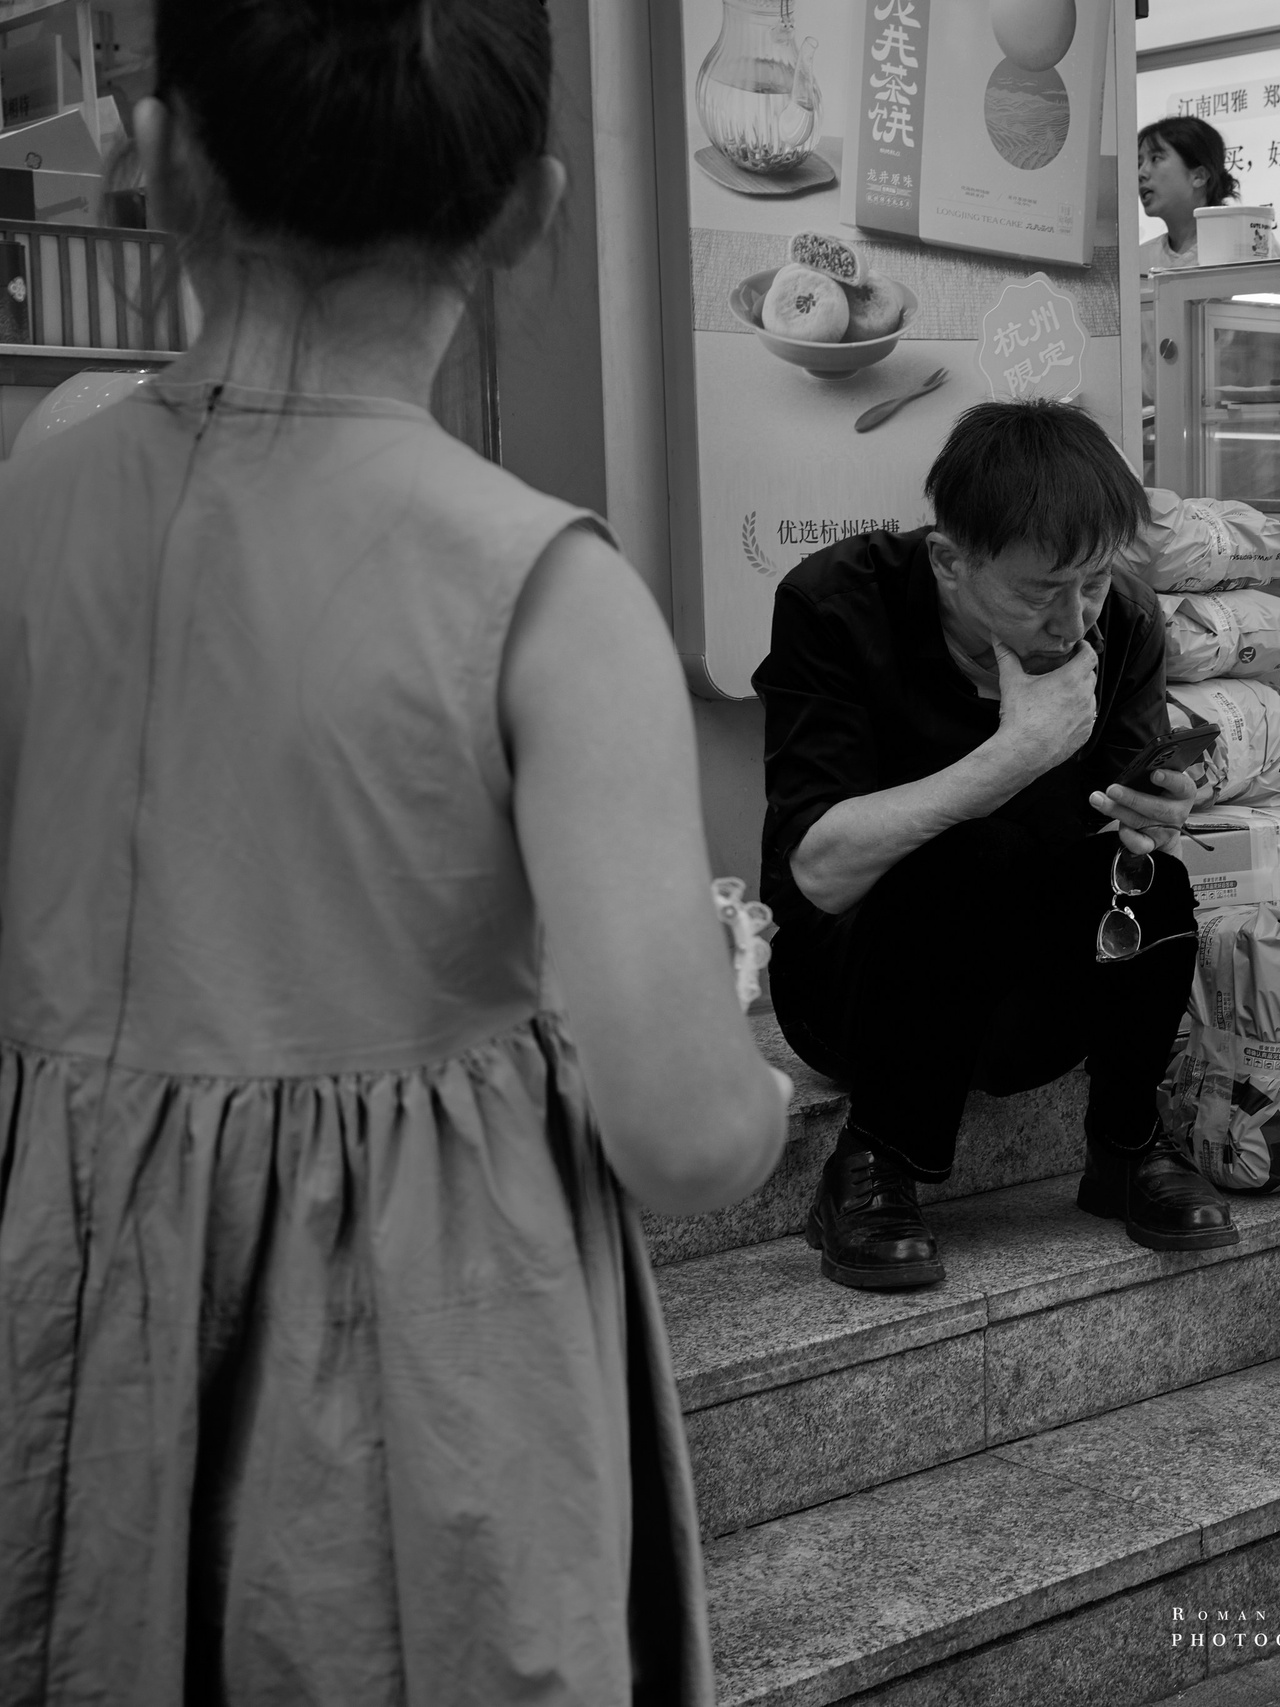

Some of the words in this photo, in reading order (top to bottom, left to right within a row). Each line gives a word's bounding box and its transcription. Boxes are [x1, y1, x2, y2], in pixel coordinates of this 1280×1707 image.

[1177, 89, 1248, 118] 江南四雅
[936, 207, 980, 221] LONGJING
[981, 215, 998, 225] TEA
[999, 218, 1023, 228] CAKE
[993, 300, 1060, 358] 杭州
[1003, 340, 1074, 393] 限定
[1241, 648, 1254, 663] XL
